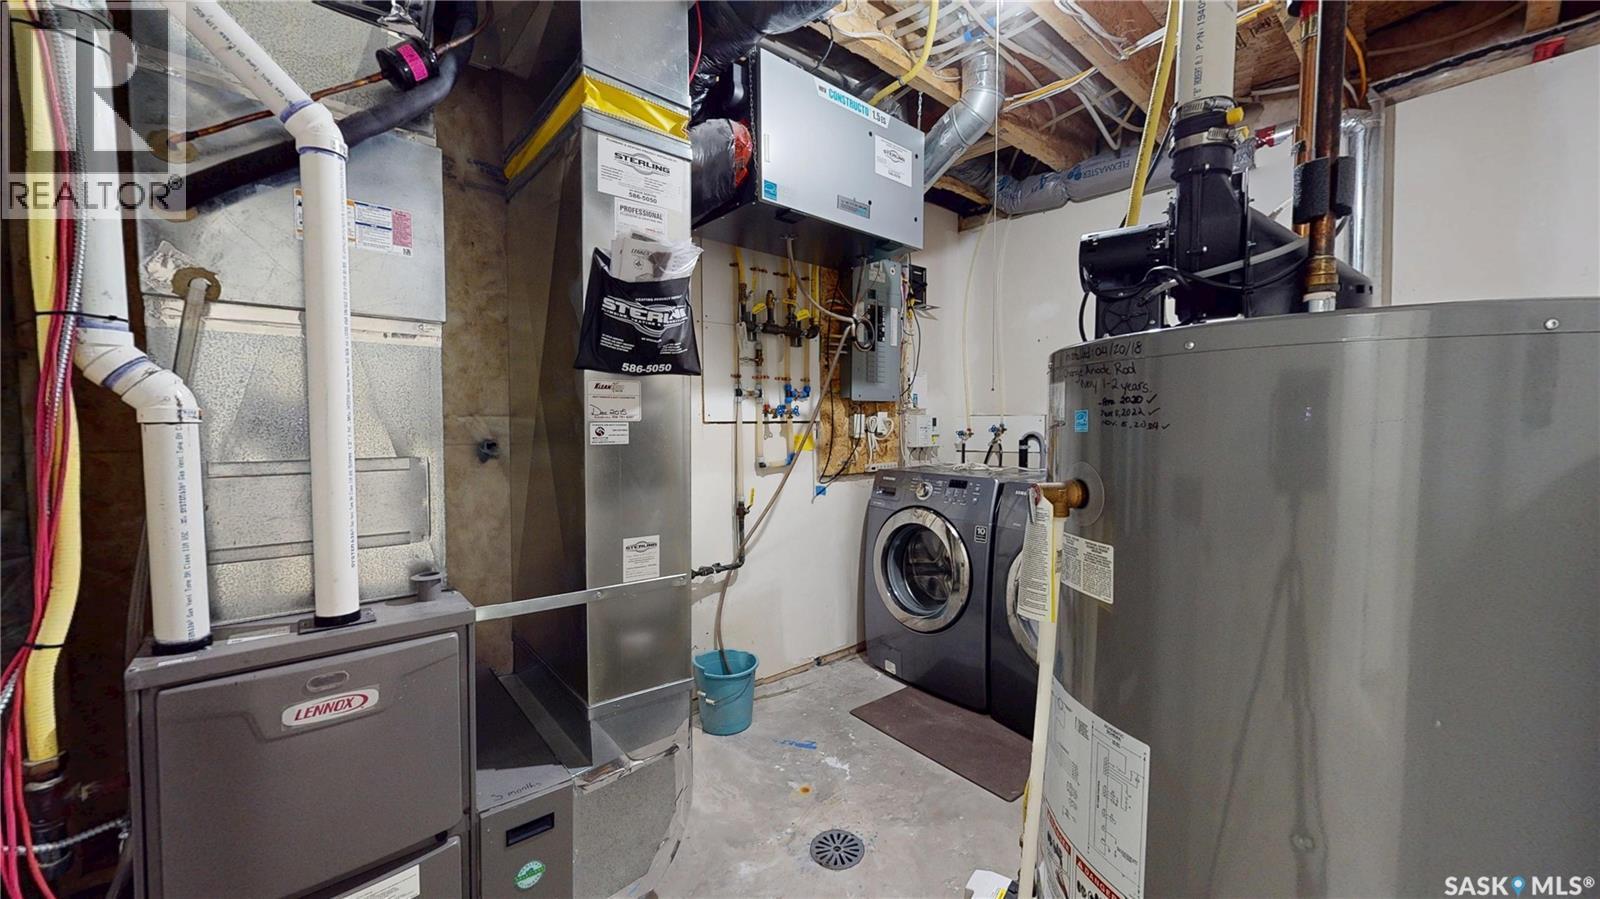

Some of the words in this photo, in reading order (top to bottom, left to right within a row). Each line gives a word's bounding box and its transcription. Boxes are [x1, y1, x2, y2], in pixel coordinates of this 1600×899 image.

[828, 88, 870, 117] CONSTRUCTO
[614, 152, 671, 174] STERLING
[619, 205, 664, 220] PROFESSIONAL
[621, 362, 672, 373] 586-5050
[1114, 361, 1137, 376] Rod
[977, 527, 986, 535] 10
[294, 696, 355, 721] LENNOX
